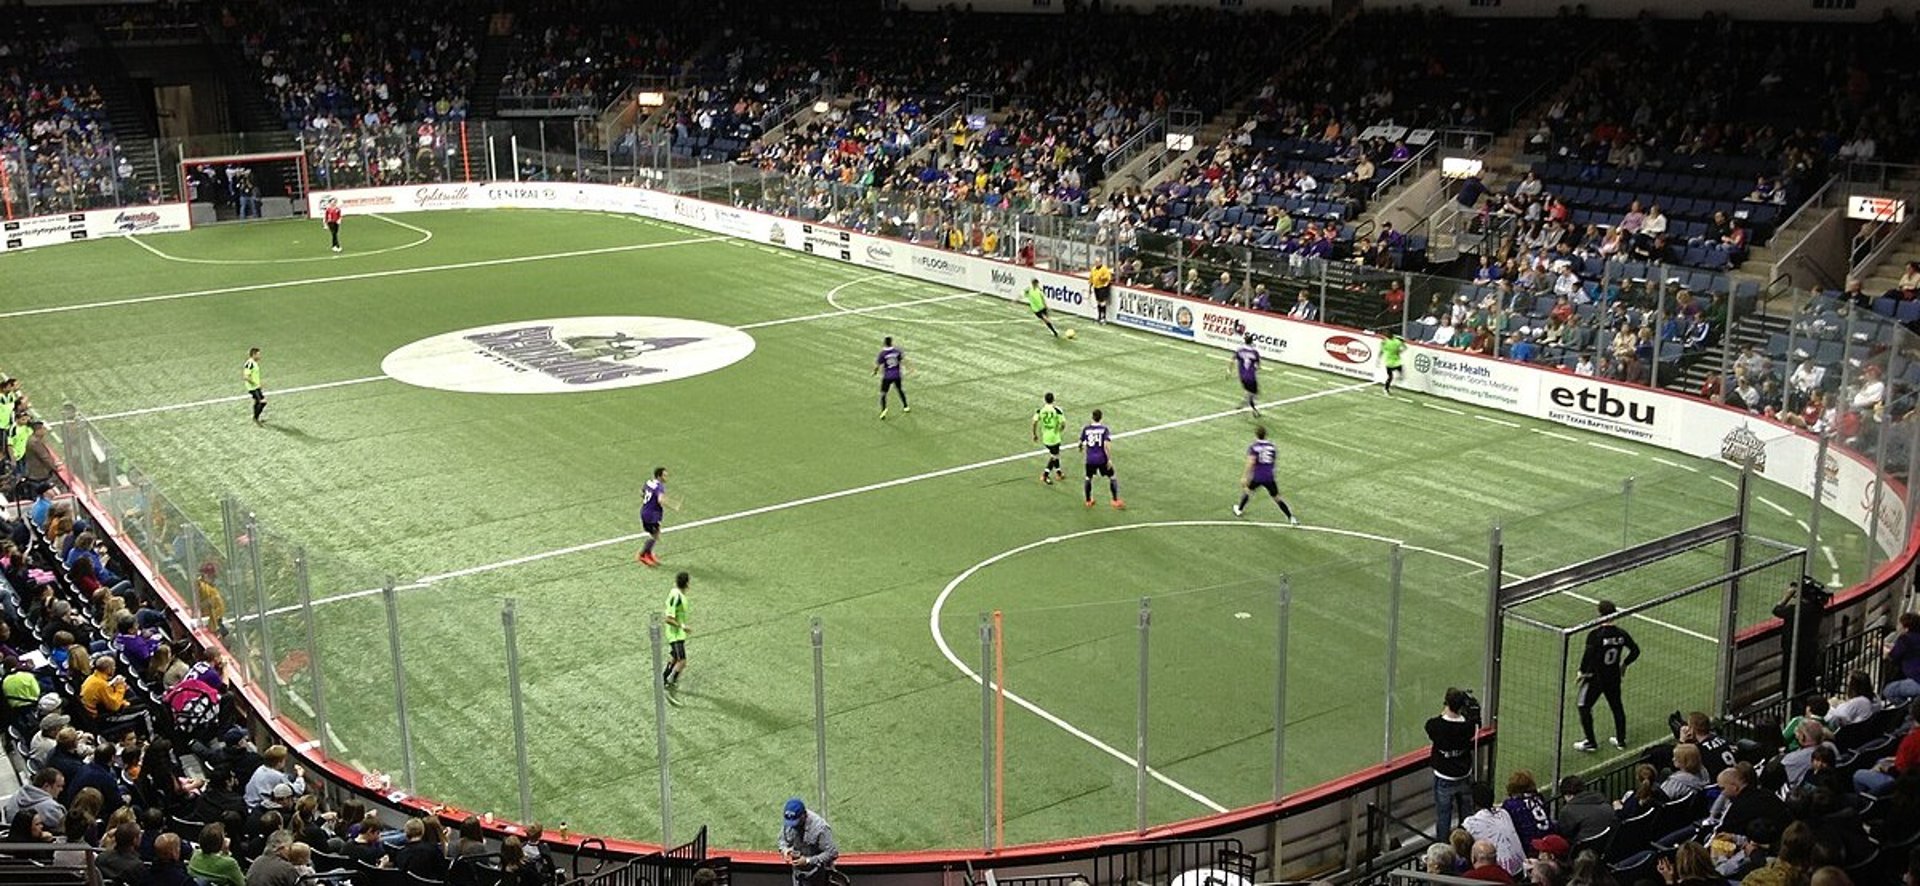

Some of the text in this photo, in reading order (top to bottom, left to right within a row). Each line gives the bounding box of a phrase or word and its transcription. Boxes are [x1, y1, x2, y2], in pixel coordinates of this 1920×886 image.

[1043, 284, 1082, 305] metro
[1119, 298, 1134, 315] ALL
[1202, 322, 1234, 336] TEXAS
[1244, 332, 1288, 348] SOCCER
[1432, 356, 1491, 378] Texas Health
[1550, 387, 1656, 426] etbu
[1587, 420, 1614, 431] BAPTIST
[1615, 425, 1654, 440] UNIVERSITY
[1087, 432, 1102, 447] 84
[1604, 648, 1617, 665] 0
[1532, 806, 1549, 831] 9
